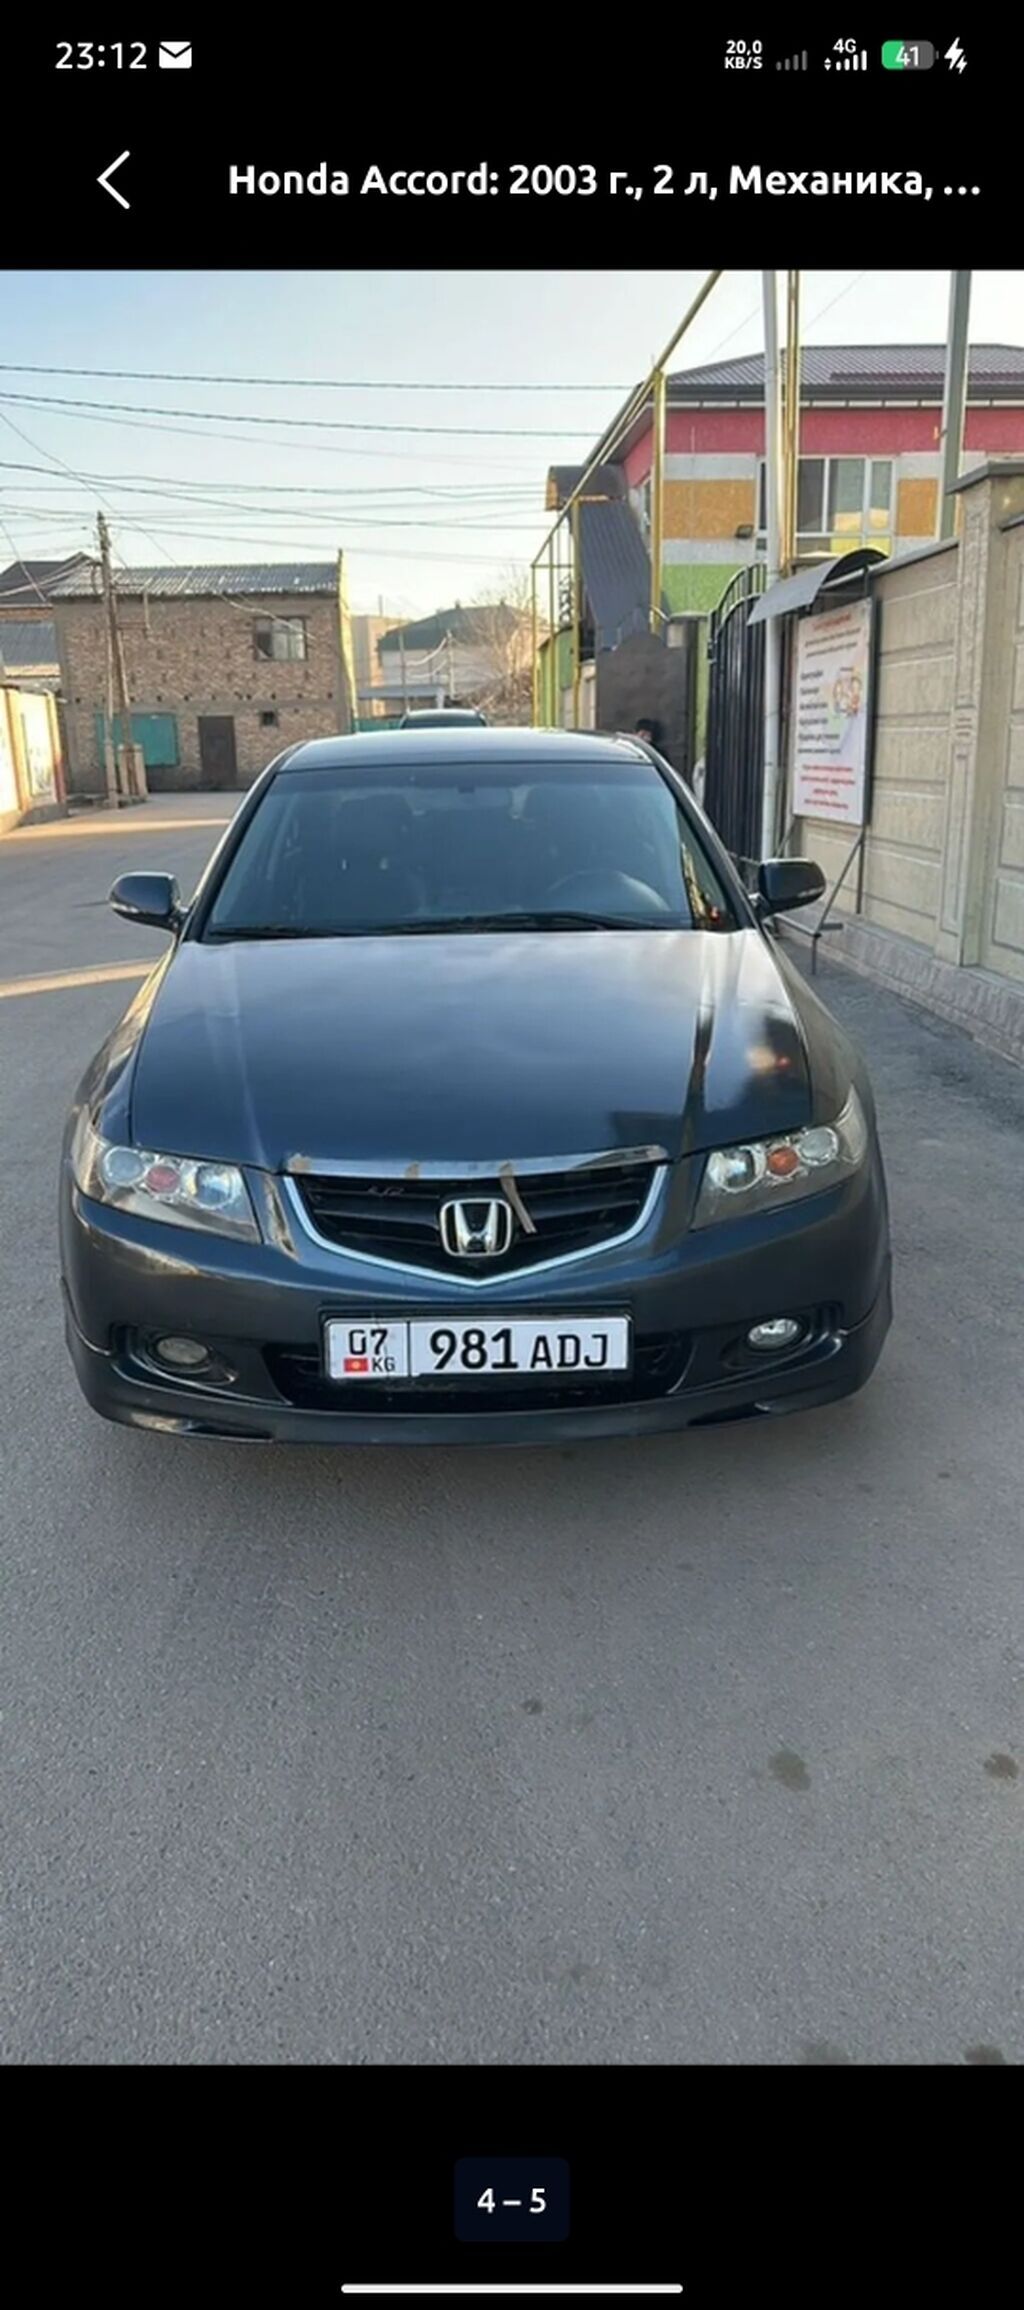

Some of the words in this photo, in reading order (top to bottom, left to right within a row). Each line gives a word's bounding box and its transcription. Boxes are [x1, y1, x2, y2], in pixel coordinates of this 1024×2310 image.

[348, 1329, 388, 1357] 07
[429, 1328, 519, 1370] 981
[530, 1333, 609, 1370] ADJ
[372, 1358, 396, 1373] KG
